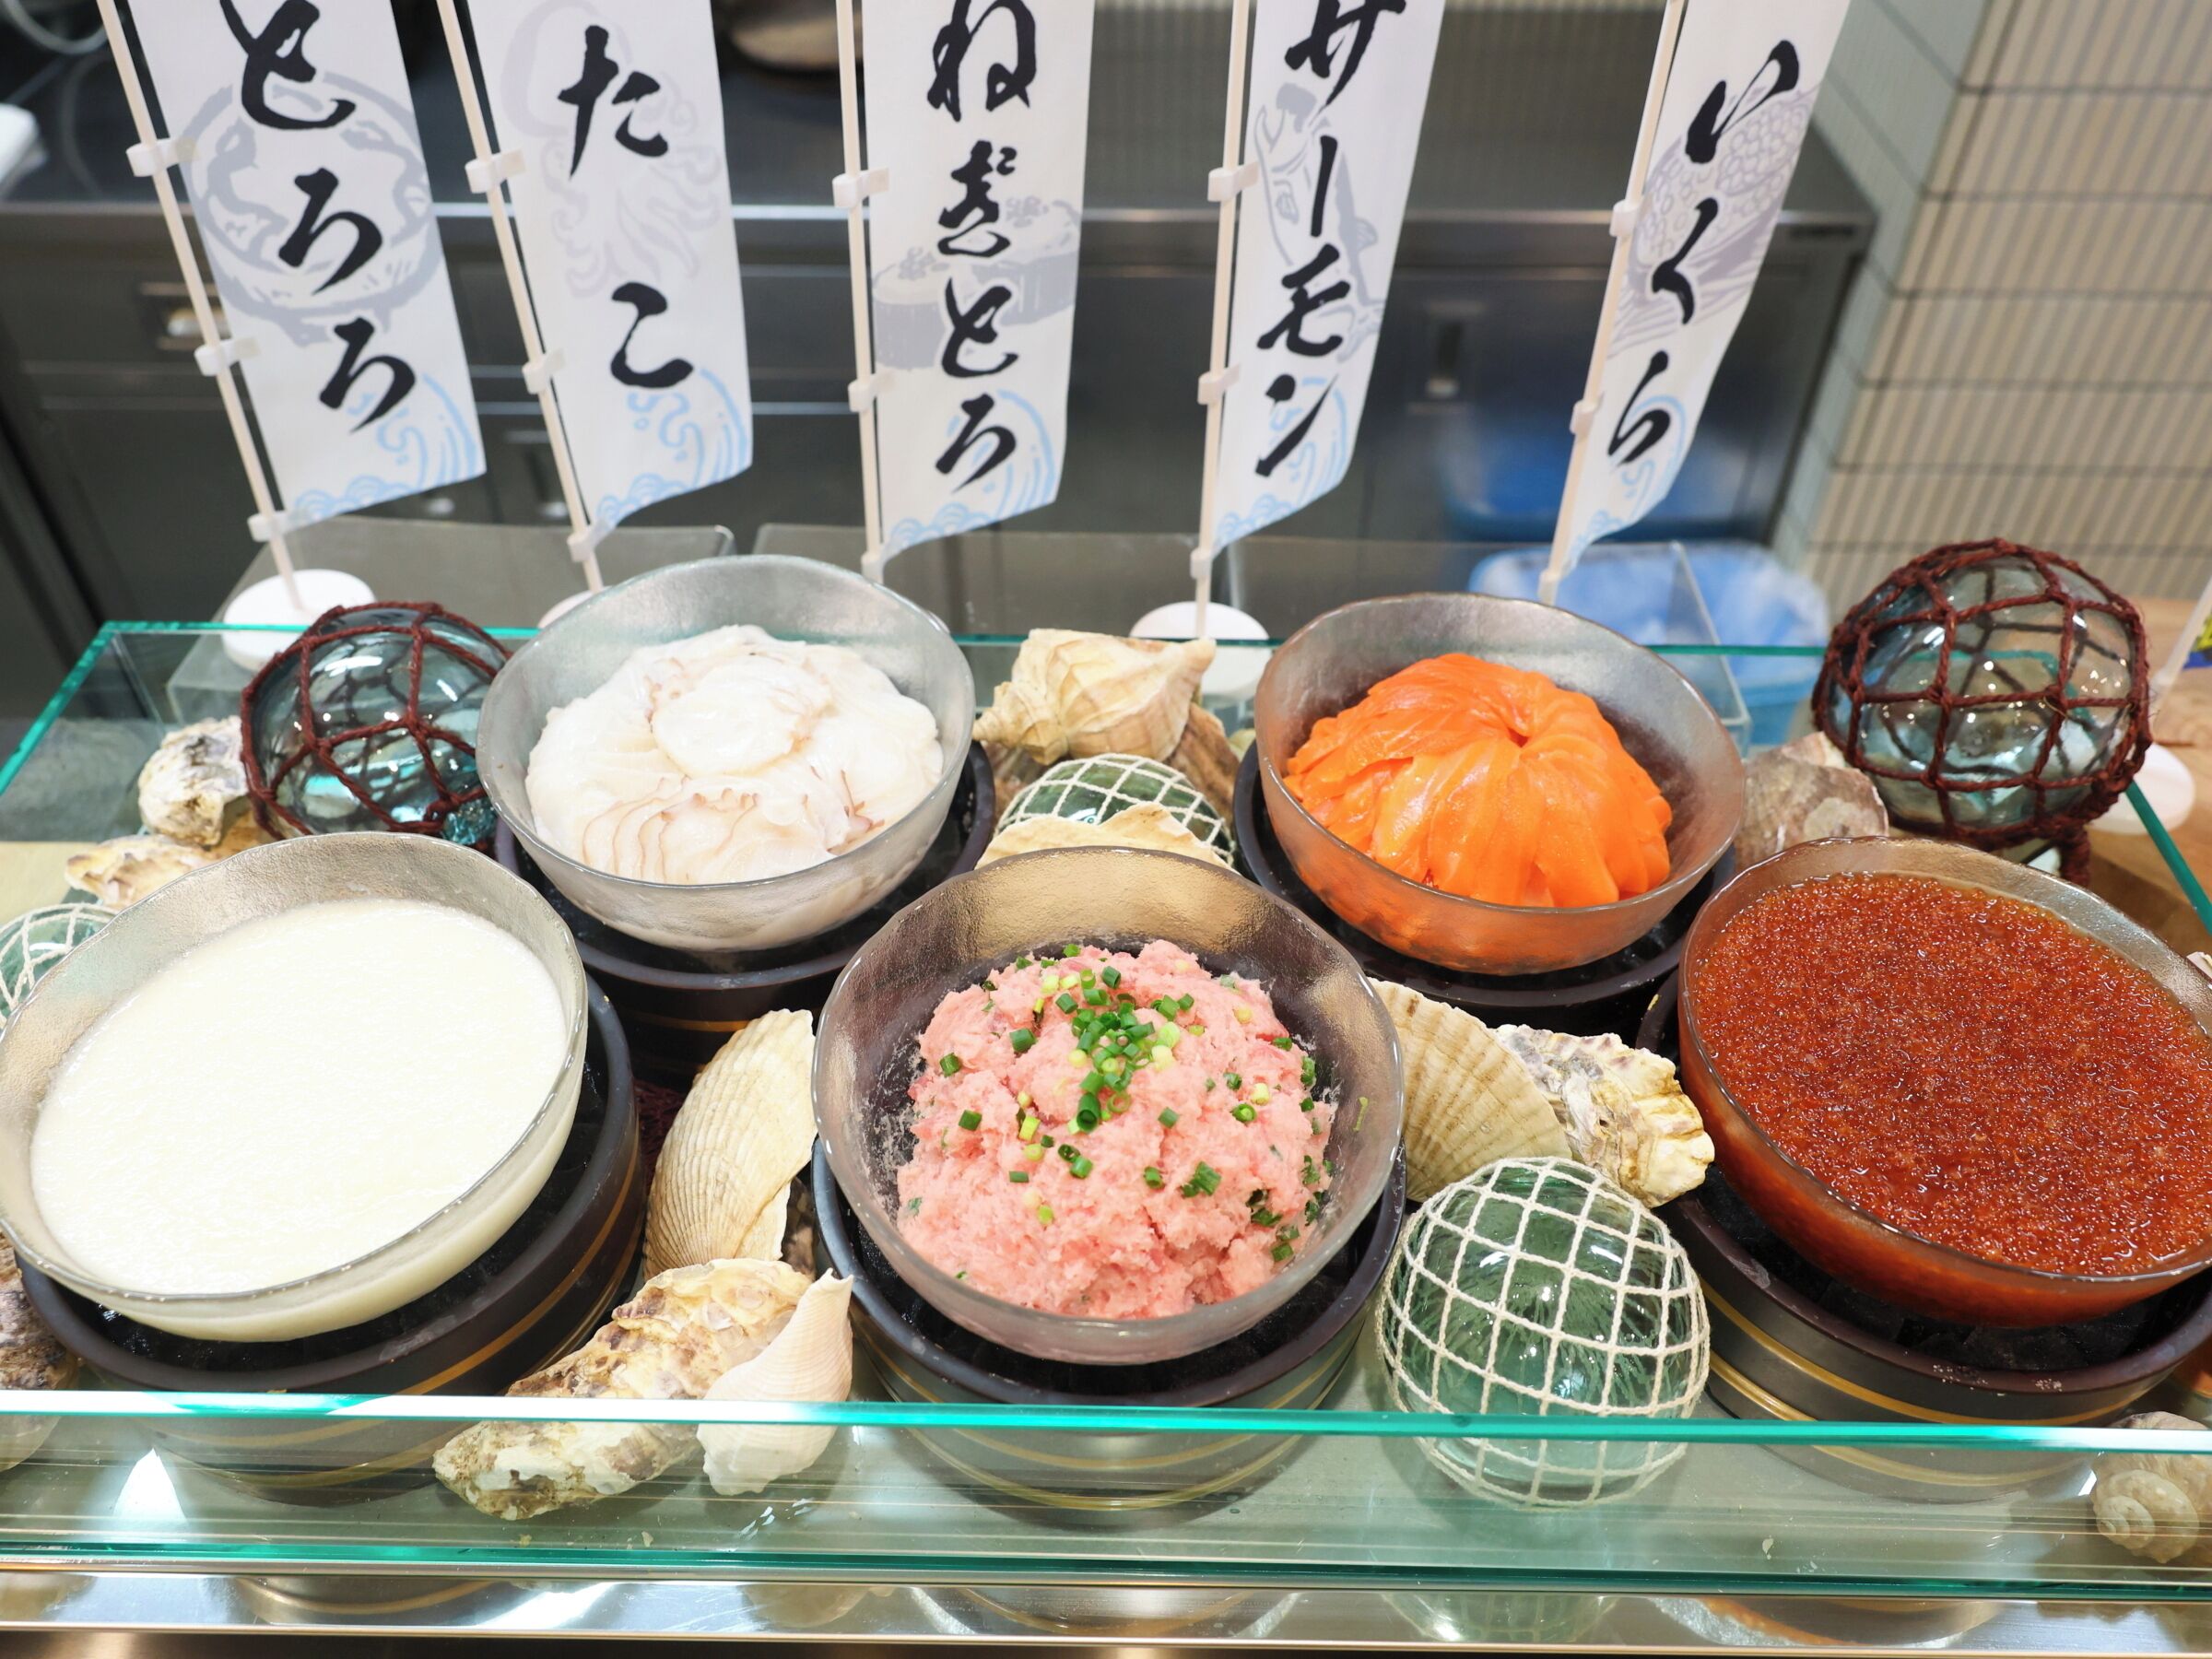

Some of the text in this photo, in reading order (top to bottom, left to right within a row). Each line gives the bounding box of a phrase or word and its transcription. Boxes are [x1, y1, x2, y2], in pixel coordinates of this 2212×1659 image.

[218, 0, 417, 434] とろろ
[558, 25, 694, 389] たこ
[927, 0, 1037, 492] ねぎとろ
[1256, 0, 1406, 477] サーモン
[1607, 40, 1800, 465] いくら
